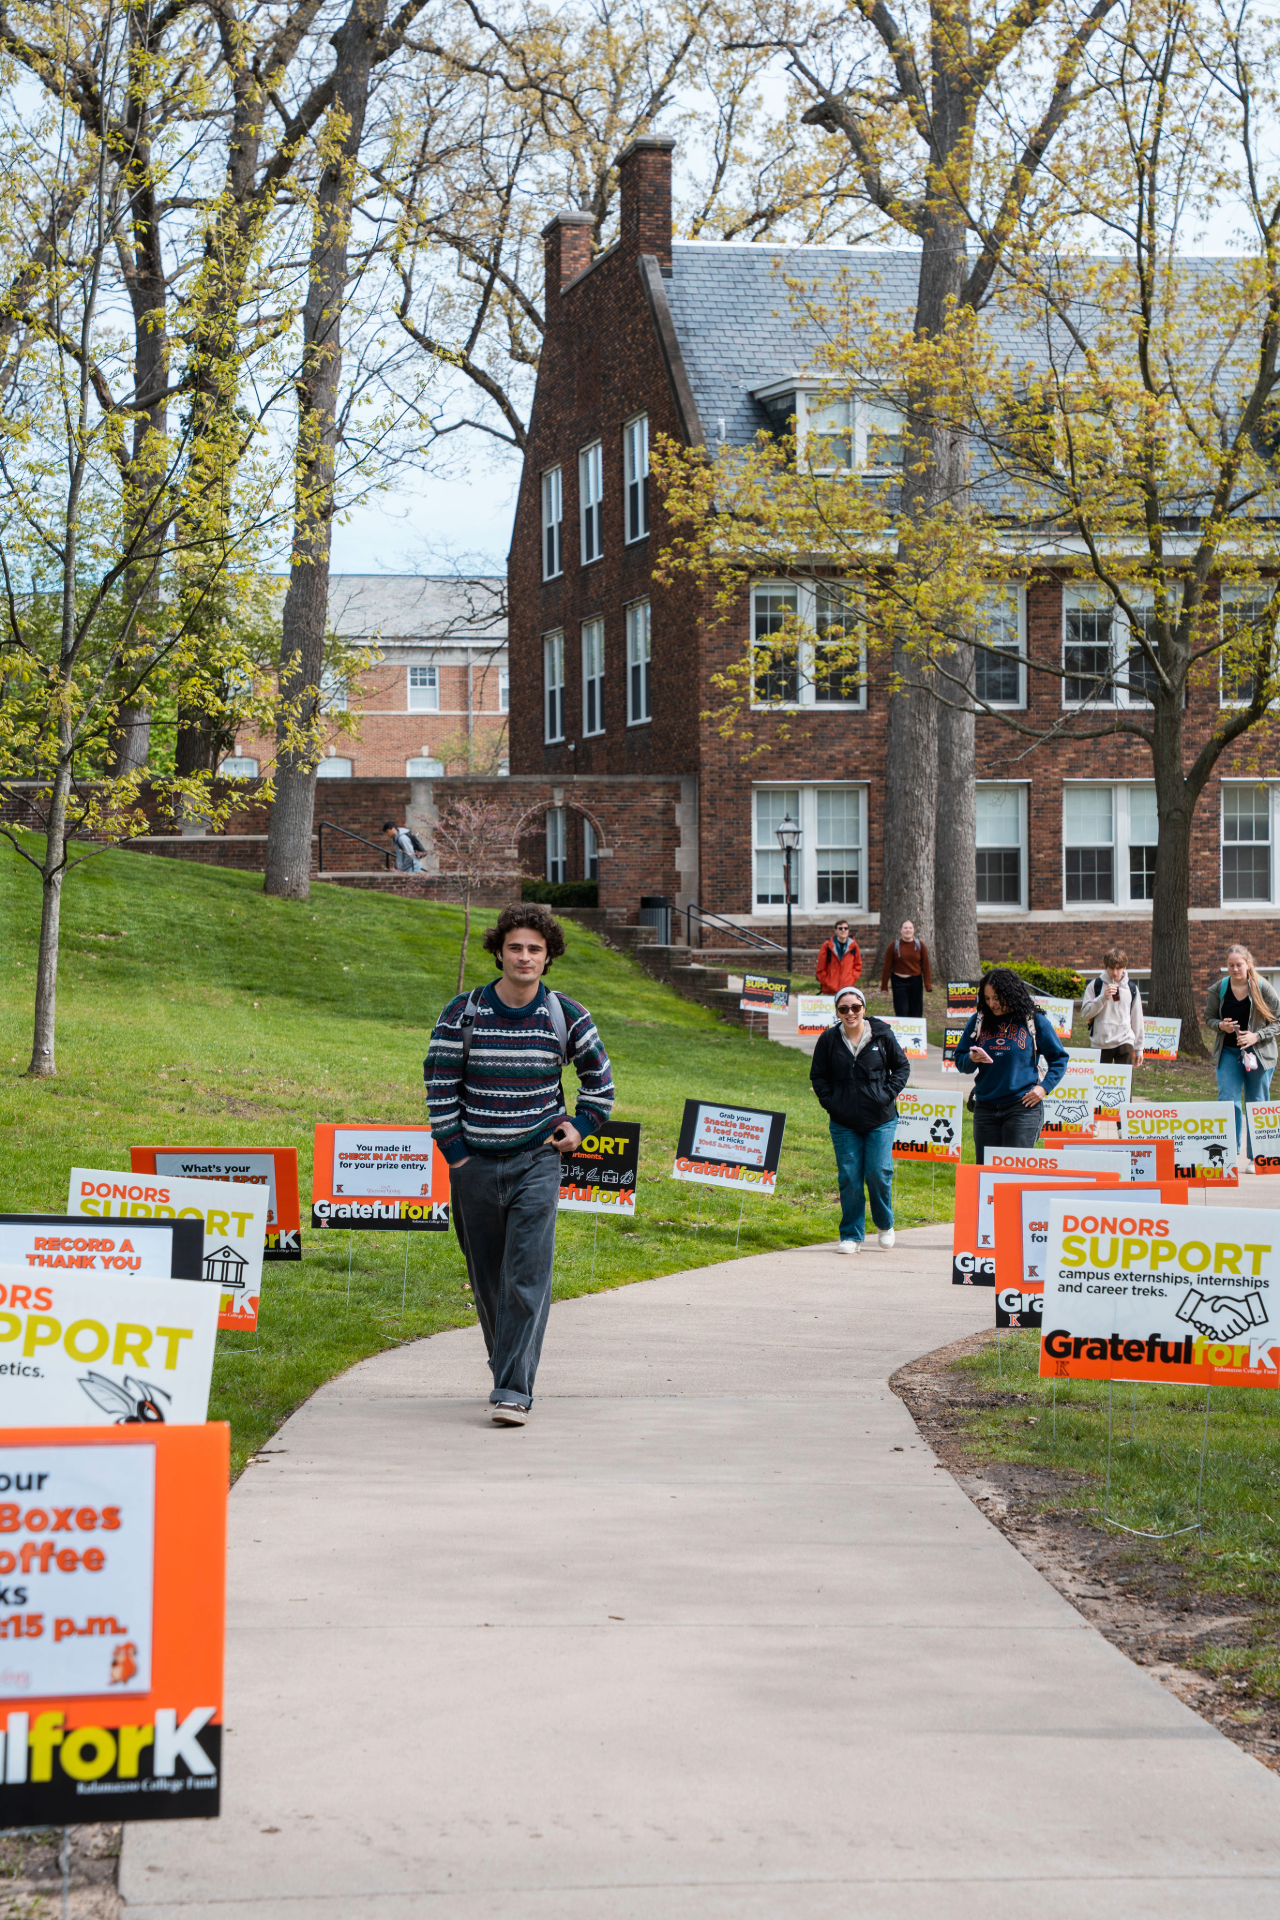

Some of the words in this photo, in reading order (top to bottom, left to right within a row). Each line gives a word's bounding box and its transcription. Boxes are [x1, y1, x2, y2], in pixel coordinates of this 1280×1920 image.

[745, 980, 787, 992] SUPPORT
[948, 987, 980, 995] SUPPO
[801, 1003, 835, 1011] SUPPO
[947, 1006, 978, 1014] Grateful
[1040, 1004, 1070, 1014] PPORT
[890, 1025, 922, 1033] PPORT
[1144, 1025, 1178, 1034] PPORT
[1143, 1047, 1177, 1057] efulforK
[1066, 1067, 1095, 1075] ONORS
[896, 1093, 918, 1103] ORS
[1044, 1087, 1088, 1100] PORT
[719, 1112, 735, 1120] Grab
[896, 1102, 956, 1118] PPORT
[1126, 1109, 1178, 1119] DONORS
[1252, 1106, 1280, 1116] DONO
[704, 1117, 737, 1129] Snackie
[739, 1122, 764, 1133] Boxes
[1042, 1120, 1093, 1133] fulforK
[1127, 1118, 1228, 1135] SUPPORT
[705, 1125, 711, 1133] &
[733, 1129, 760, 1140] coffee
[1187, 1134, 1227, 1142] engagement
[356, 1144, 373, 1152] You
[698, 1139, 716, 1147] 10:45
[727, 1137, 744, 1145] Hicks
[892, 1139, 960, 1156] tefulforK
[338, 1152, 371, 1160] CHECK
[372, 1153, 383, 1161] IN
[384, 1153, 398, 1161] AT
[400, 1153, 429, 1161] HICKS
[572, 1151, 604, 1160] rtments.
[992, 1155, 1058, 1170] DONORS
[224, 1165, 251, 1174] your
[376, 1162, 399, 1170] prize
[401, 1162, 427, 1170] entry.
[676, 1157, 776, 1185] GratefulforK
[1175, 1162, 1237, 1179] fulforK
[232, 1175, 268, 1184] SPOT
[80, 1181, 171, 1204] DONORS
[558, 1183, 634, 1206] efulforK
[313, 1199, 449, 1220] GratefulforK
[1062, 1214, 1170, 1238] DONORS
[34, 1236, 115, 1252] RECORD
[119, 1239, 135, 1252] A
[25, 1253, 96, 1269] THANK
[99, 1256, 142, 1270] YOU
[1059, 1234, 1272, 1276] SUPPORT
[1027, 1265, 1039, 1277] K
[1058, 1269, 1110, 1282] campus
[1114, 1272, 1193, 1287] externships,
[1197, 1274, 1270, 1289] internships
[1057, 1282, 1082, 1294] and
[1086, 1284, 1128, 1296] career
[1131, 1285, 1168, 1298] treks.
[1009, 1313, 1021, 1327] K
[0, 1311, 194, 1371] PPORT
[1044, 1329, 1278, 1369] GratefulforK
[0, 1362, 45, 1379] etics.
[1055, 1361, 1069, 1376] K
[1243, 1367, 1262, 1375] College
[0, 1472, 49, 1491] our
[0, 1503, 121, 1533] Boxes
[0, 1541, 105, 1575] offee
[0, 1613, 44, 1639] :15
[54, 1615, 127, 1643] p.m.
[0, 1706, 217, 1785] lforK
[76, 1781, 140, 1795] Kalamazoo
[141, 1777, 184, 1794] College
[186, 1775, 217, 1790] Fund
